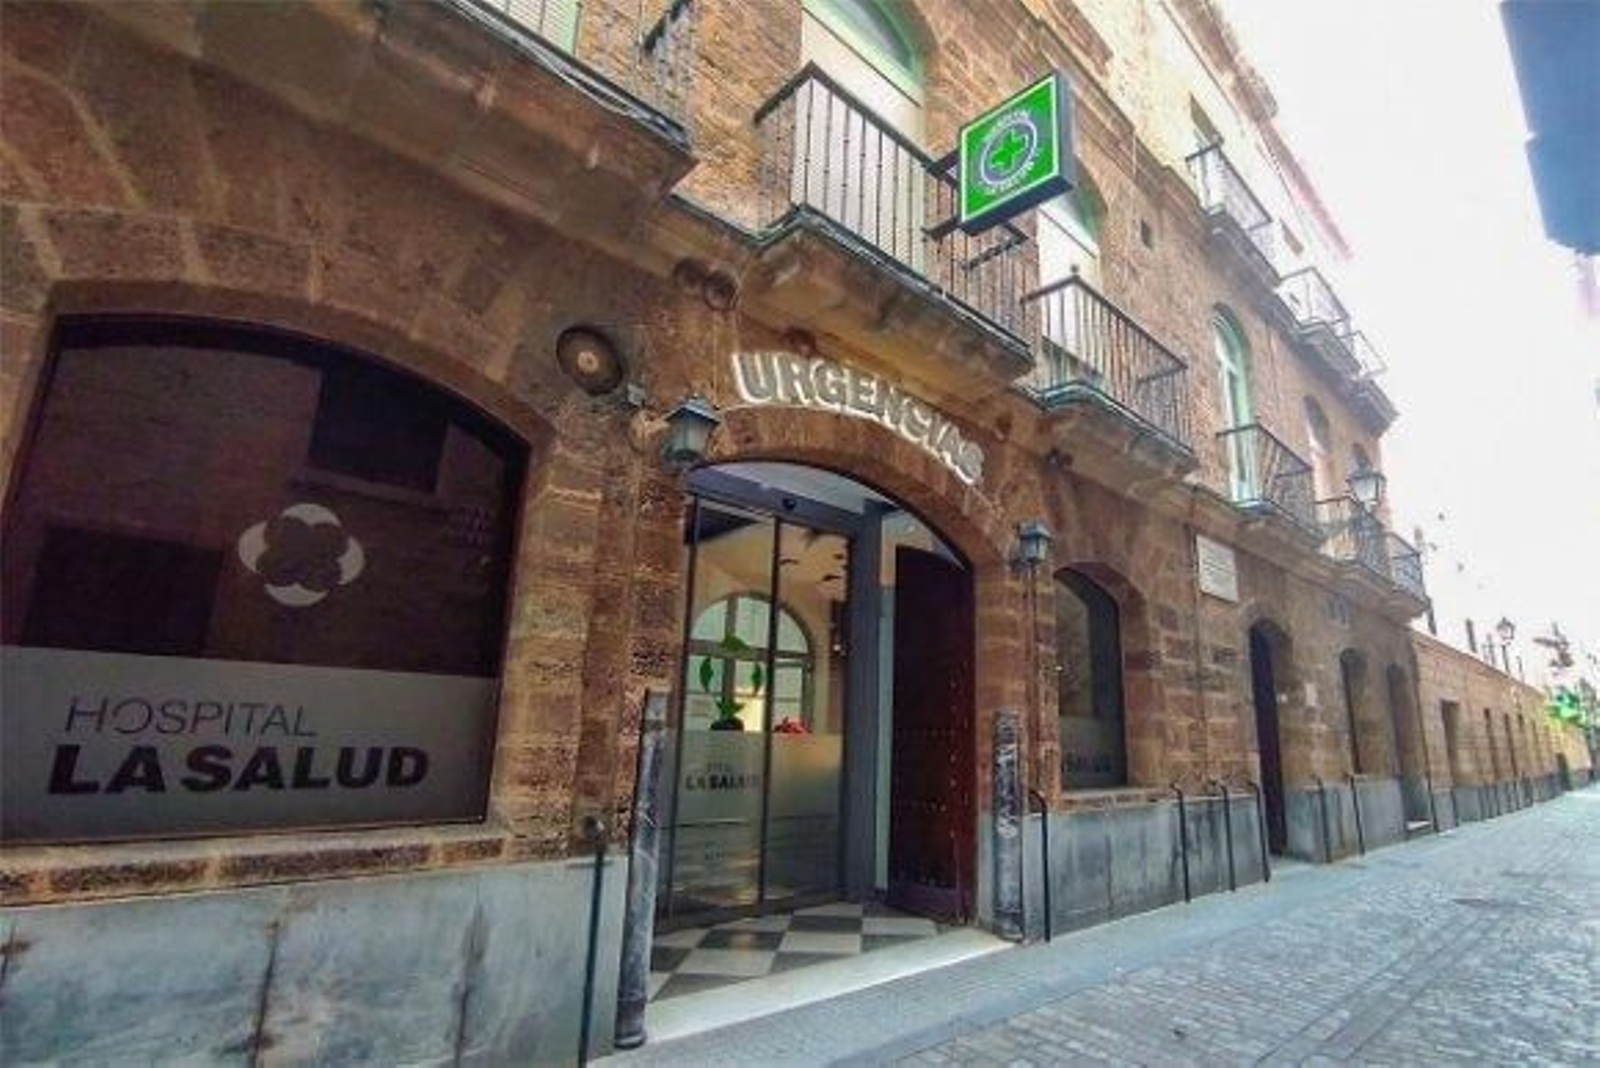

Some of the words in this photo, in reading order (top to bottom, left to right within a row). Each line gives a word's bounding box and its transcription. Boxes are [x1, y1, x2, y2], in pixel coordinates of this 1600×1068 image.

[732, 351, 984, 485] URGENCIAS
[64, 696, 317, 737] HOSPITAL
[48, 744, 167, 795] LA
[181, 745, 429, 793] SALUD
